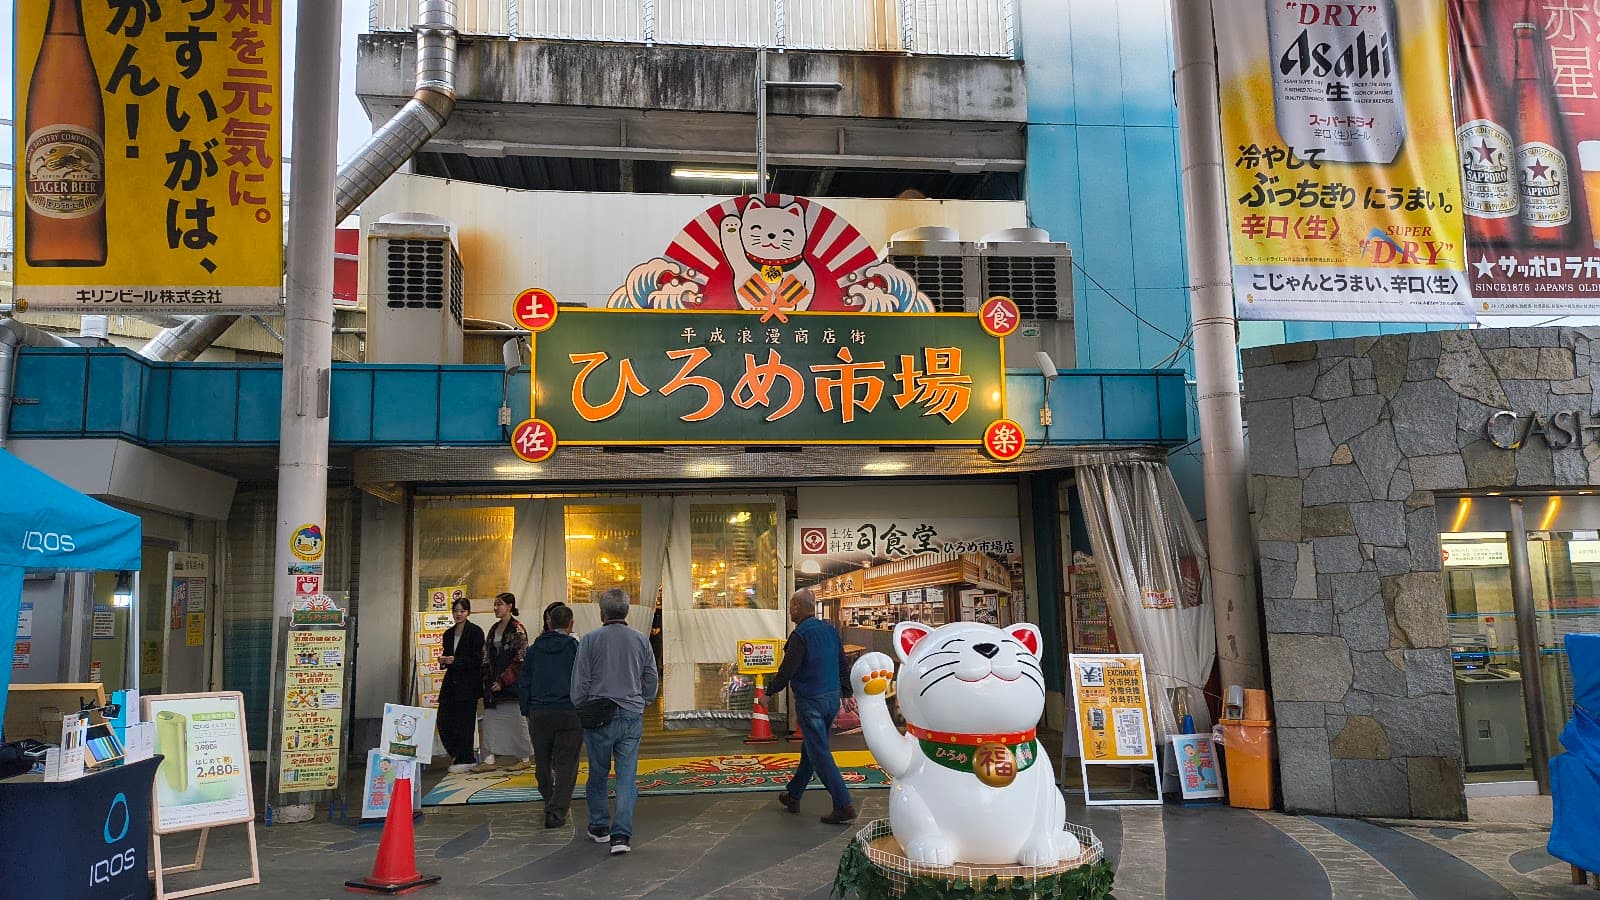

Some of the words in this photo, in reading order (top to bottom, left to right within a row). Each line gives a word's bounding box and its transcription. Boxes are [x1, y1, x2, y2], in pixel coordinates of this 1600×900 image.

[1280, 28, 1391, 79] Asahi
[1325, 81, 1352, 102] 生
[1309, 114, 1375, 128] スーパードライ
[1235, 143, 1326, 171] 冷やして
[34, 181, 68, 193] LAGER
[71, 181, 96, 193] BEER
[1466, 170, 1507, 183] SAPPORO
[1239, 173, 1356, 211] ぶっちぎり
[1364, 186, 1453, 215] にうまい。
[1386, 225, 1432, 237] SUPER
[76, 289, 222, 304] キリンビール株式会社
[1534, 283, 1574, 292] JAPAN'S
[521, 294, 550, 320] 土
[986, 302, 1015, 329] 食
[680, 327, 867, 345] 平成浪漫商店街
[568, 346, 973, 425] ひろめ市場
[517, 426, 550, 455] 佐
[991, 427, 1019, 453] 楽
[22, 530, 76, 553] IQOS
[830, 528, 854, 540] 土佐
[856, 523, 940, 556] 司食堂
[830, 540, 854, 553] 料理
[943, 540, 1016, 555] ひろめ市場店
[1107, 669, 1138, 677] EXCHANGE
[935, 747, 968, 764] ひろめ
[980, 746, 1013, 777] 福
[89, 847, 136, 888] IQOS
